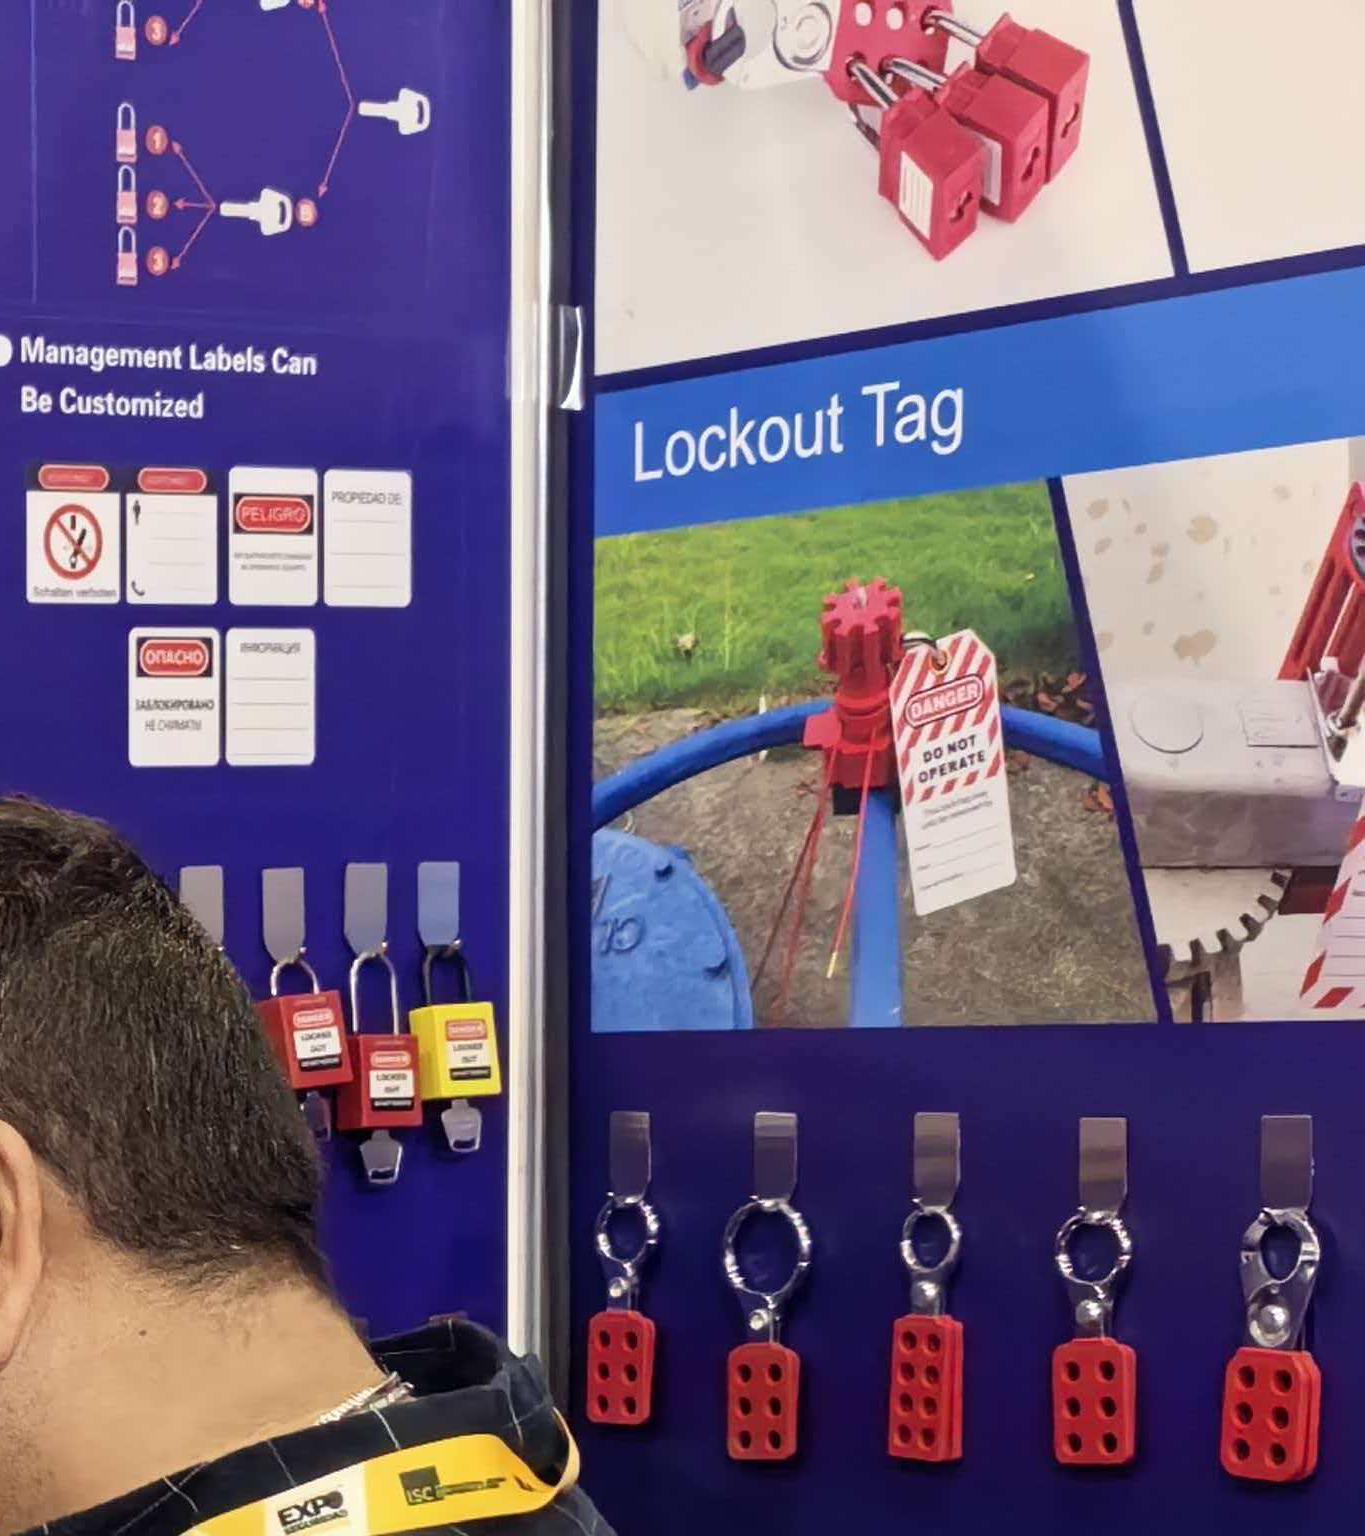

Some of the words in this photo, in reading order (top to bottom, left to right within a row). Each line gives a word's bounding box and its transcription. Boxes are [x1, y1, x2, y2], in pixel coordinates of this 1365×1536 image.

[20, 336, 182, 372] Management
[189, 345, 266, 374] Labels
[272, 349, 317, 376] Can
[21, 385, 53, 415] Be
[60, 387, 204, 419] Customized
[633, 392, 845, 482] Lockout
[861, 380, 965, 456] Tag
[242, 506, 306, 523] PELIGRO
[144, 649, 204, 666] ОПАСНО
[910, 682, 981, 719] DANGER
[922, 747, 944, 764] DO
[948, 734, 978, 755] NOT
[918, 751, 987, 784] OPERATE
[406, 1487, 435, 1505] ISC
